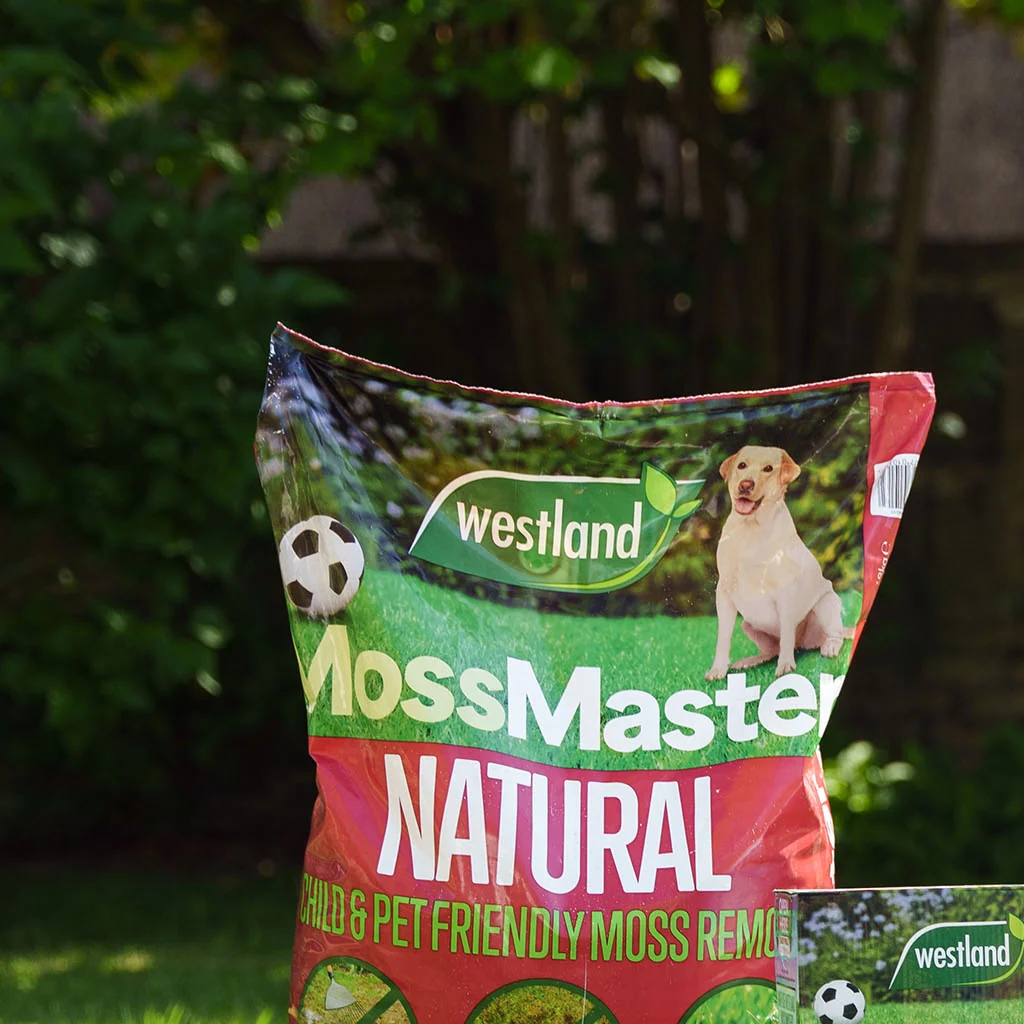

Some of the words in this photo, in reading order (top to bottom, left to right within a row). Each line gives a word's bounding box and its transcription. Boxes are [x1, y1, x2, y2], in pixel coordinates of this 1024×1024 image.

[457, 499, 642, 559] westland
[376, 754, 731, 894] NATURAL
[301, 873, 345, 935] CHILD
[350, 889, 367, 941] &
[373, 893, 428, 949] PET
[431, 900, 585, 960] FRIENDLY
[591, 908, 690, 962] MOSS
[914, 933, 1010, 969] westland
